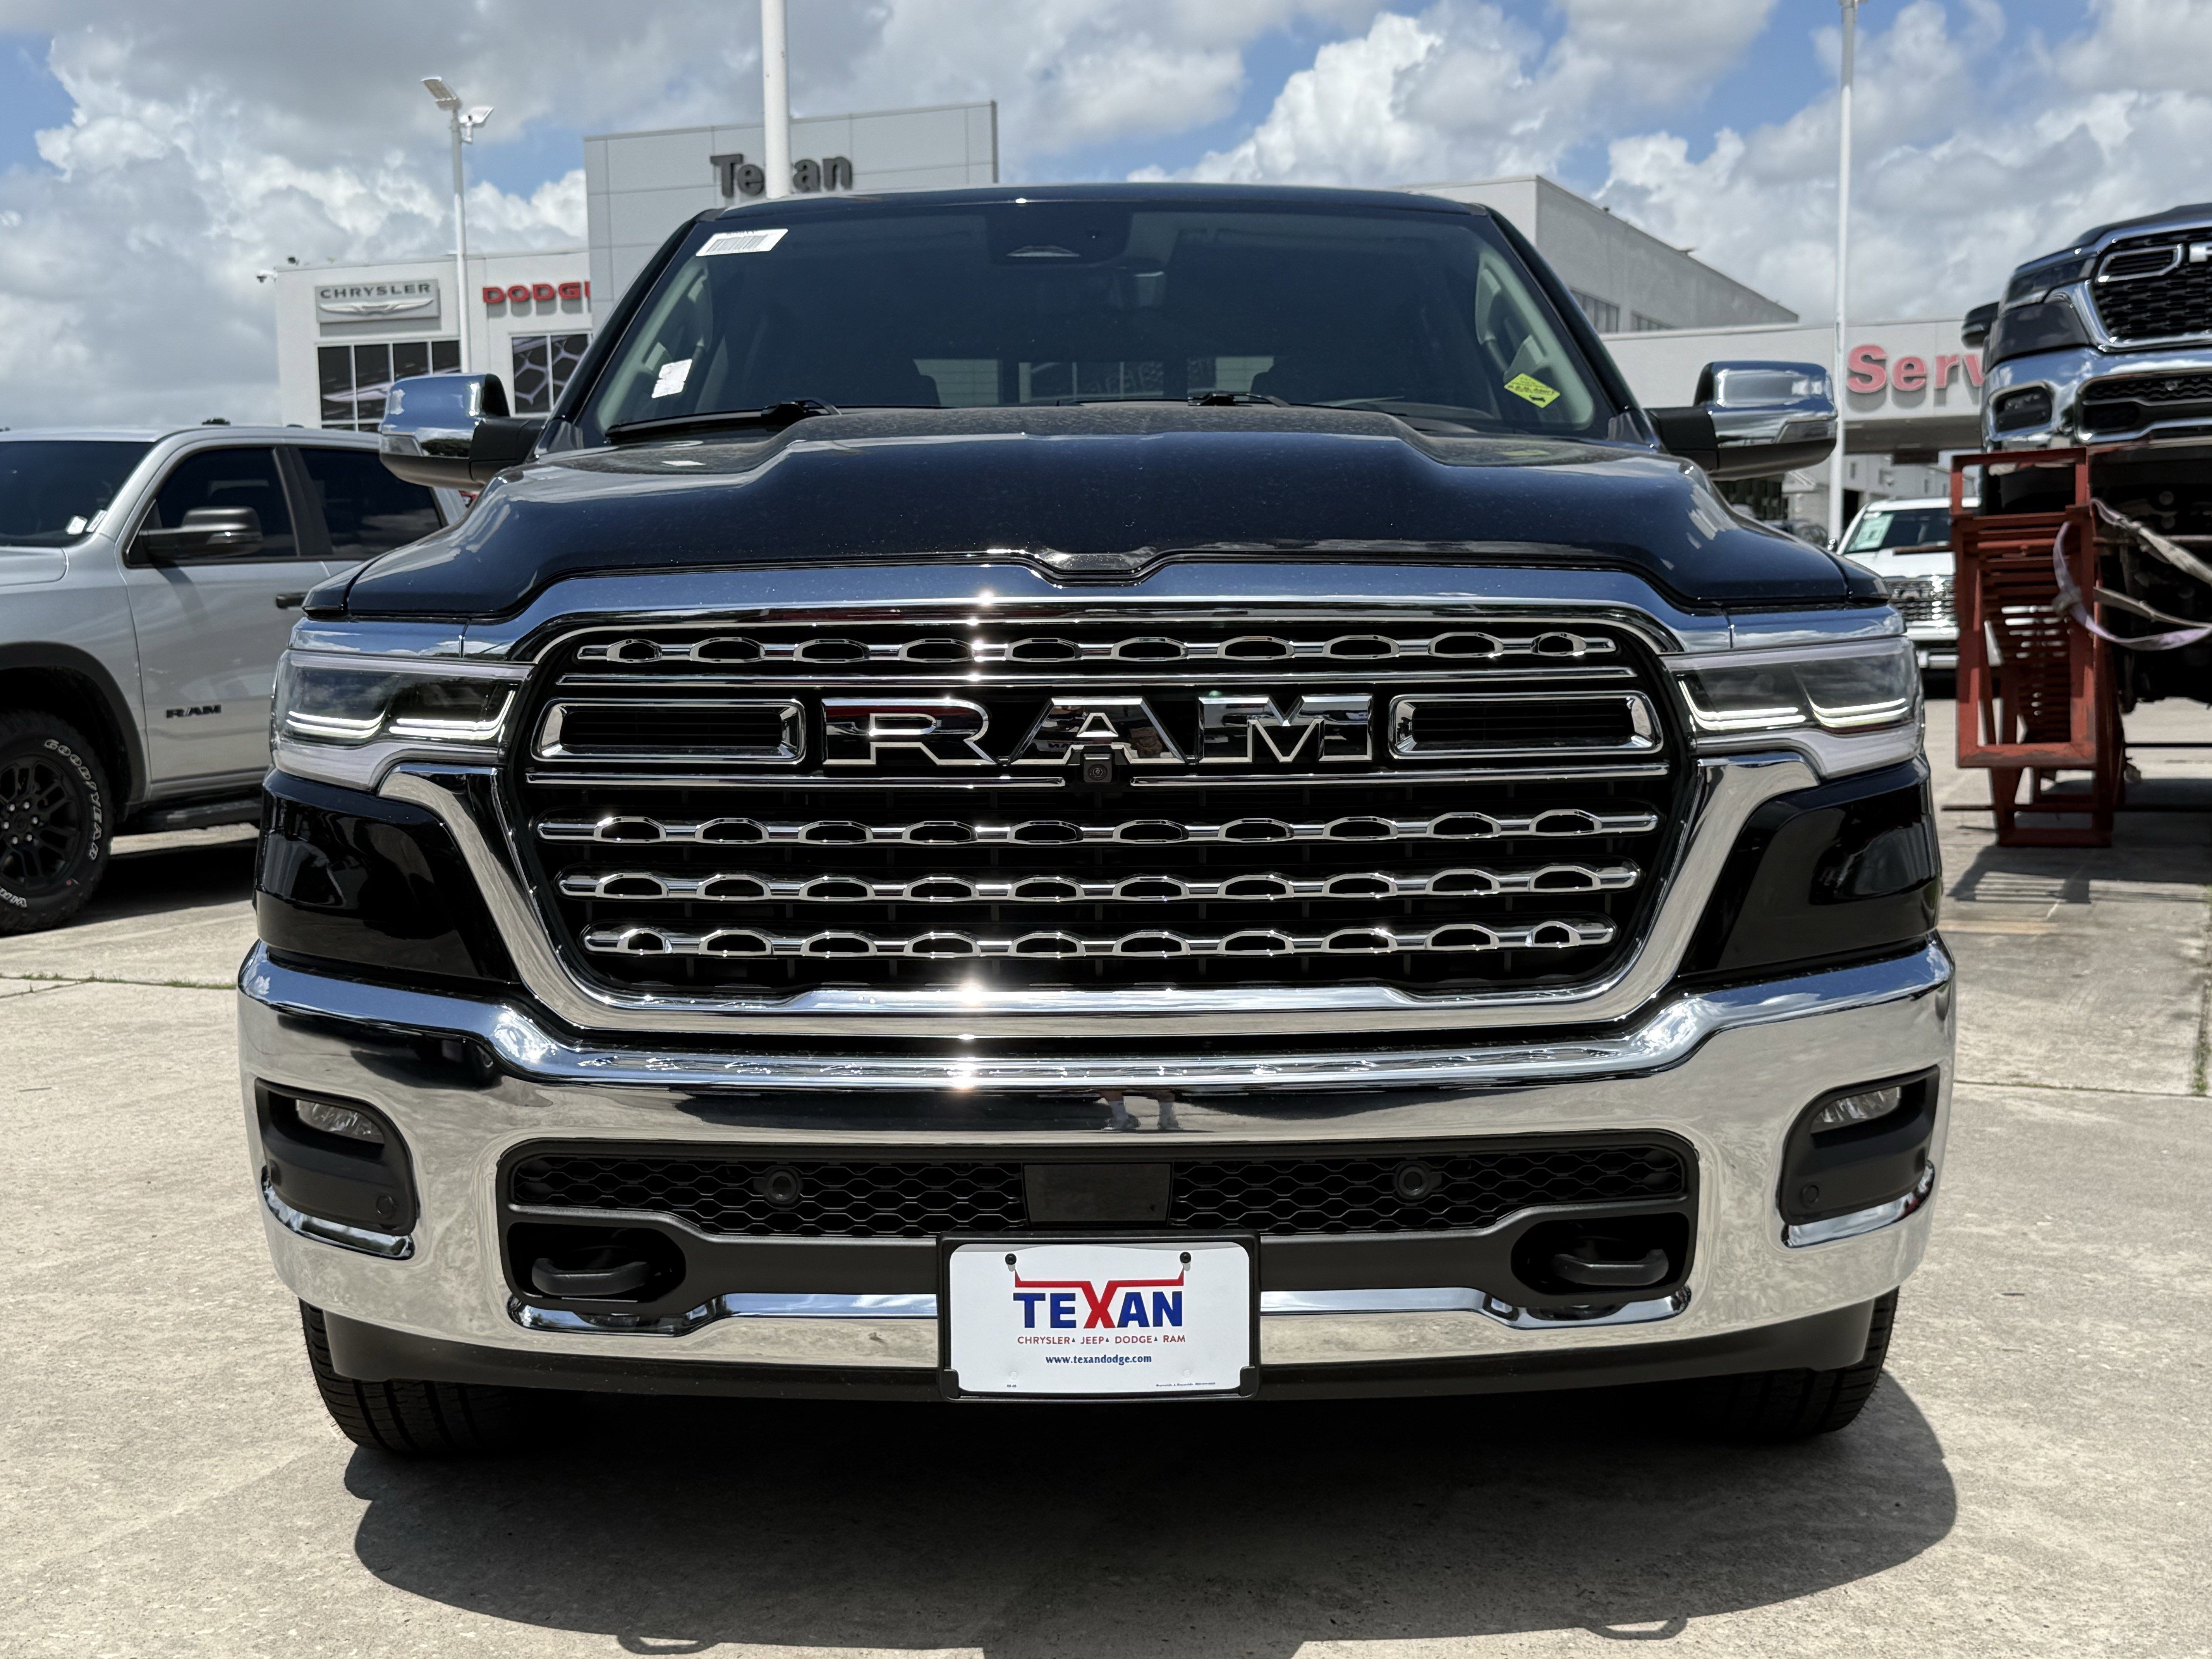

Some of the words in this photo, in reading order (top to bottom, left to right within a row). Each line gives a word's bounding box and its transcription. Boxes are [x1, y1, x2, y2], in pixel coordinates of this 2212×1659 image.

[710, 154, 853, 198] Tean
[320, 283, 431, 298] CHRYSLER
[167, 705, 222, 718] RAM
[821, 697, 1373, 765] RAM
[44, 739, 102, 860] GOODYEAR
[1013, 1272, 1183, 1329] TEXAN
[1017, 1335, 1071, 1345] CHRYSLER
[1080, 1335, 1104, 1345] JEEP
[1115, 1335, 1152, 1344] DODGE
[1163, 1334, 1186, 1343] RAM
[1046, 1355, 1152, 1366] www.texandodge.com
